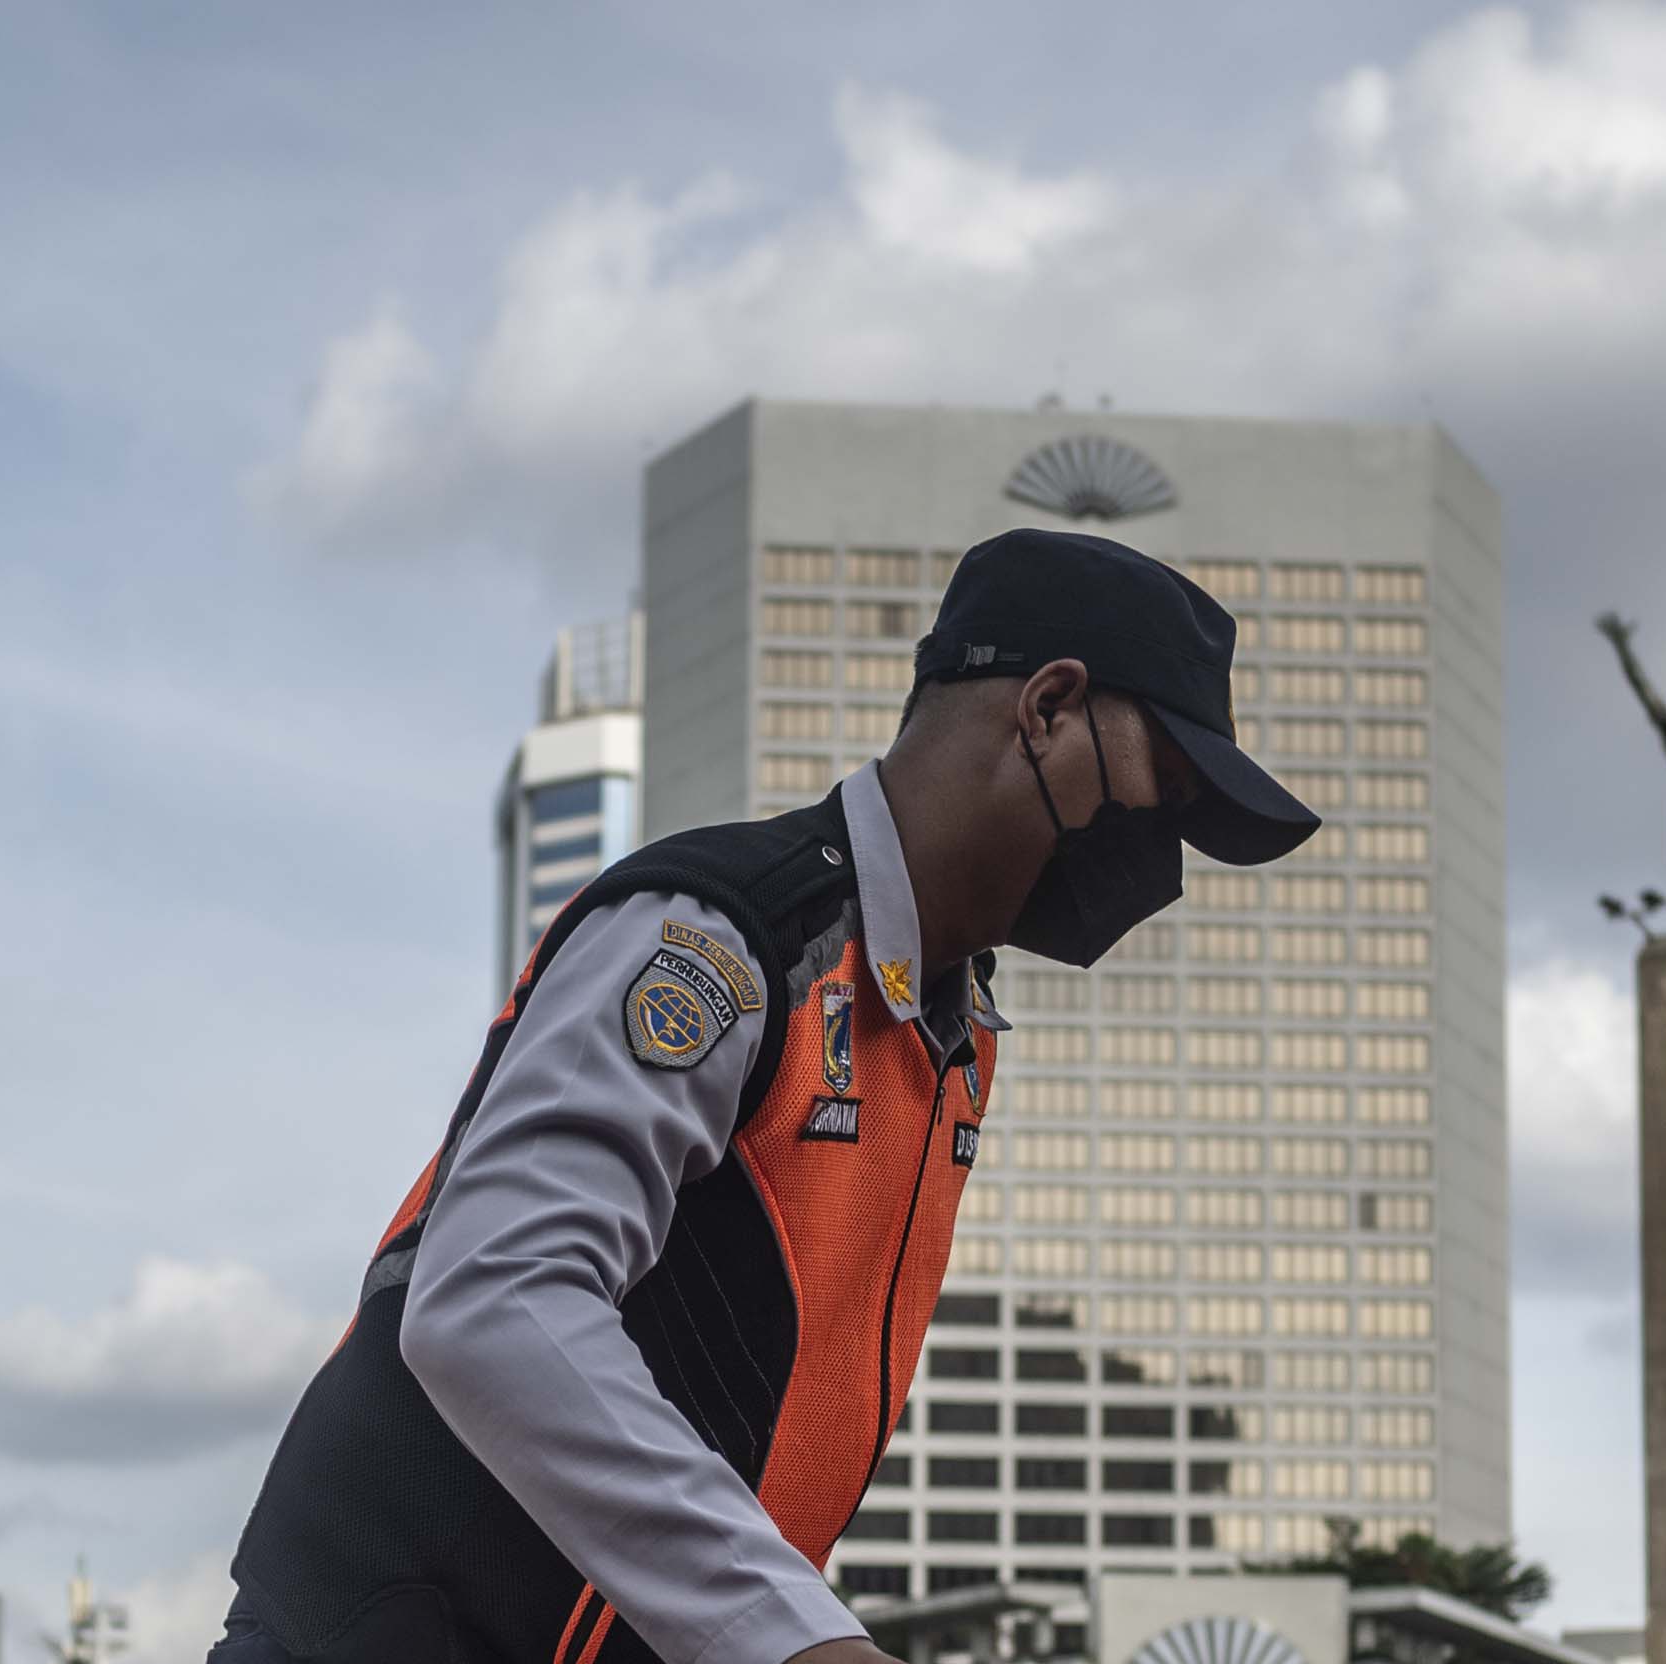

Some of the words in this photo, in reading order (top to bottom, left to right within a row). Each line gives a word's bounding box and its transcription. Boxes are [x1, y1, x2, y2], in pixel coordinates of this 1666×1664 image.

[660, 953, 734, 1022] PERHUBUNGAN
[670, 926, 703, 945] DINAS
[703, 942, 758, 1001] PERHUBUNGAN
